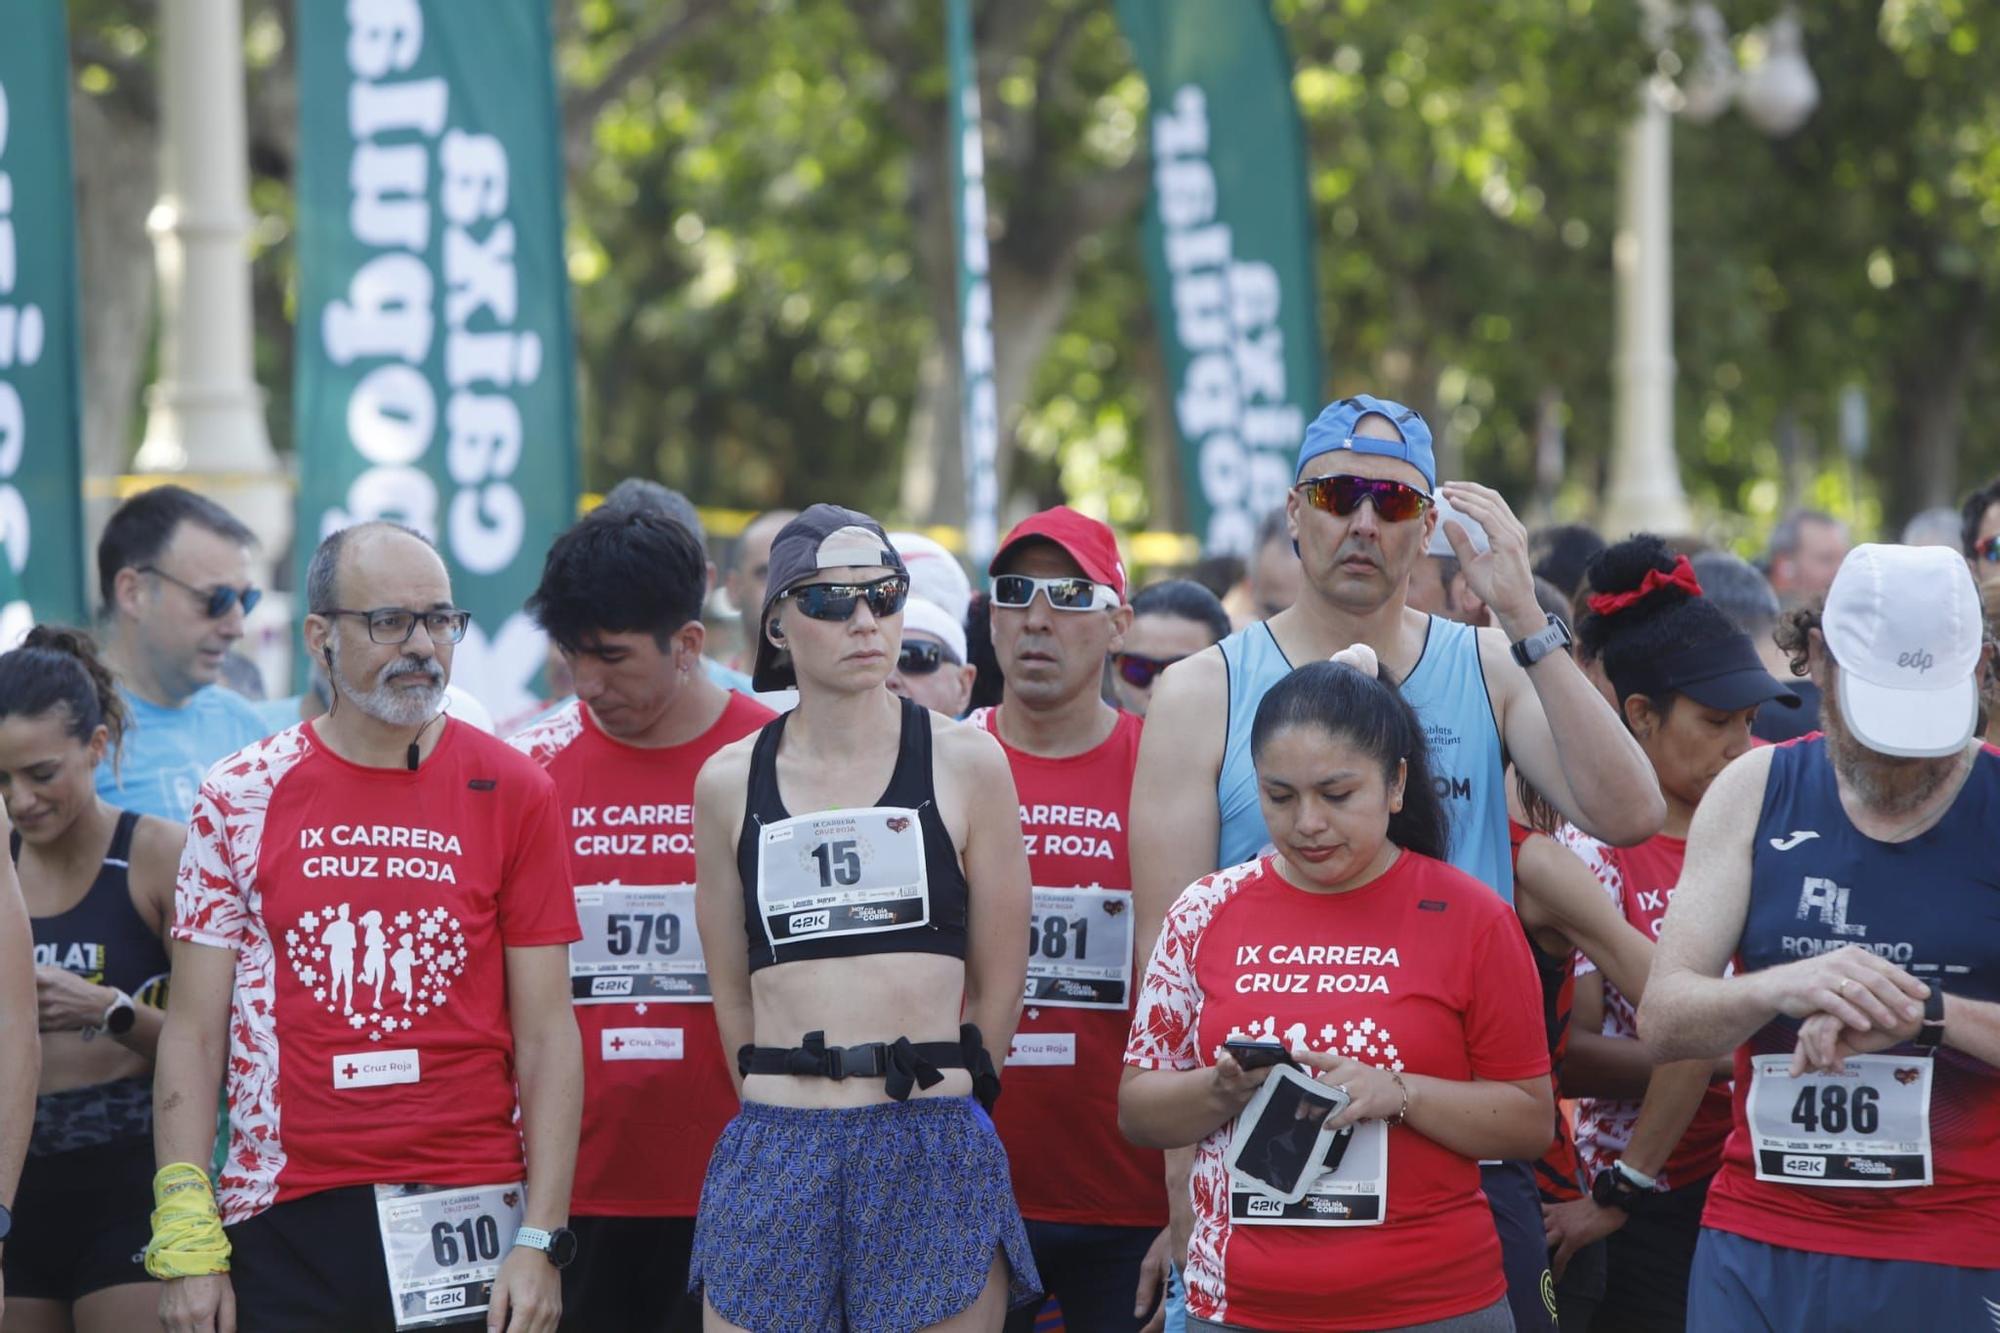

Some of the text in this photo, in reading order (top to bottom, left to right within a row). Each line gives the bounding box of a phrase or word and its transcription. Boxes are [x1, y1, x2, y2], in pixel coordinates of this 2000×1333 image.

[1896, 648, 1933, 674] edp
[572, 804, 696, 828] IX CARRE
[301, 825, 462, 856] IX CARRERA
[574, 835, 647, 856] CRUZ
[1044, 835, 1115, 860] ROJA
[303, 856, 456, 884] CRUZ ROJA
[811, 840, 861, 887] 15
[1636, 889, 1665, 911] IX
[792, 915, 825, 929] 42K
[607, 913, 680, 956] 579
[1236, 945, 1400, 967] IX CARRERA
[595, 980, 629, 991] 42K
[1235, 973, 1390, 994] CRUZ ROJA
[1022, 1043, 1068, 1054] Cruz Roja
[363, 1061, 412, 1073] Cruz Roja
[1791, 1085, 1880, 1134] 486
[1786, 1160, 1821, 1171] 42K
[1250, 1200, 1281, 1212] 42K
[431, 1215, 500, 1267] 610
[429, 1292, 462, 1306] 42K
